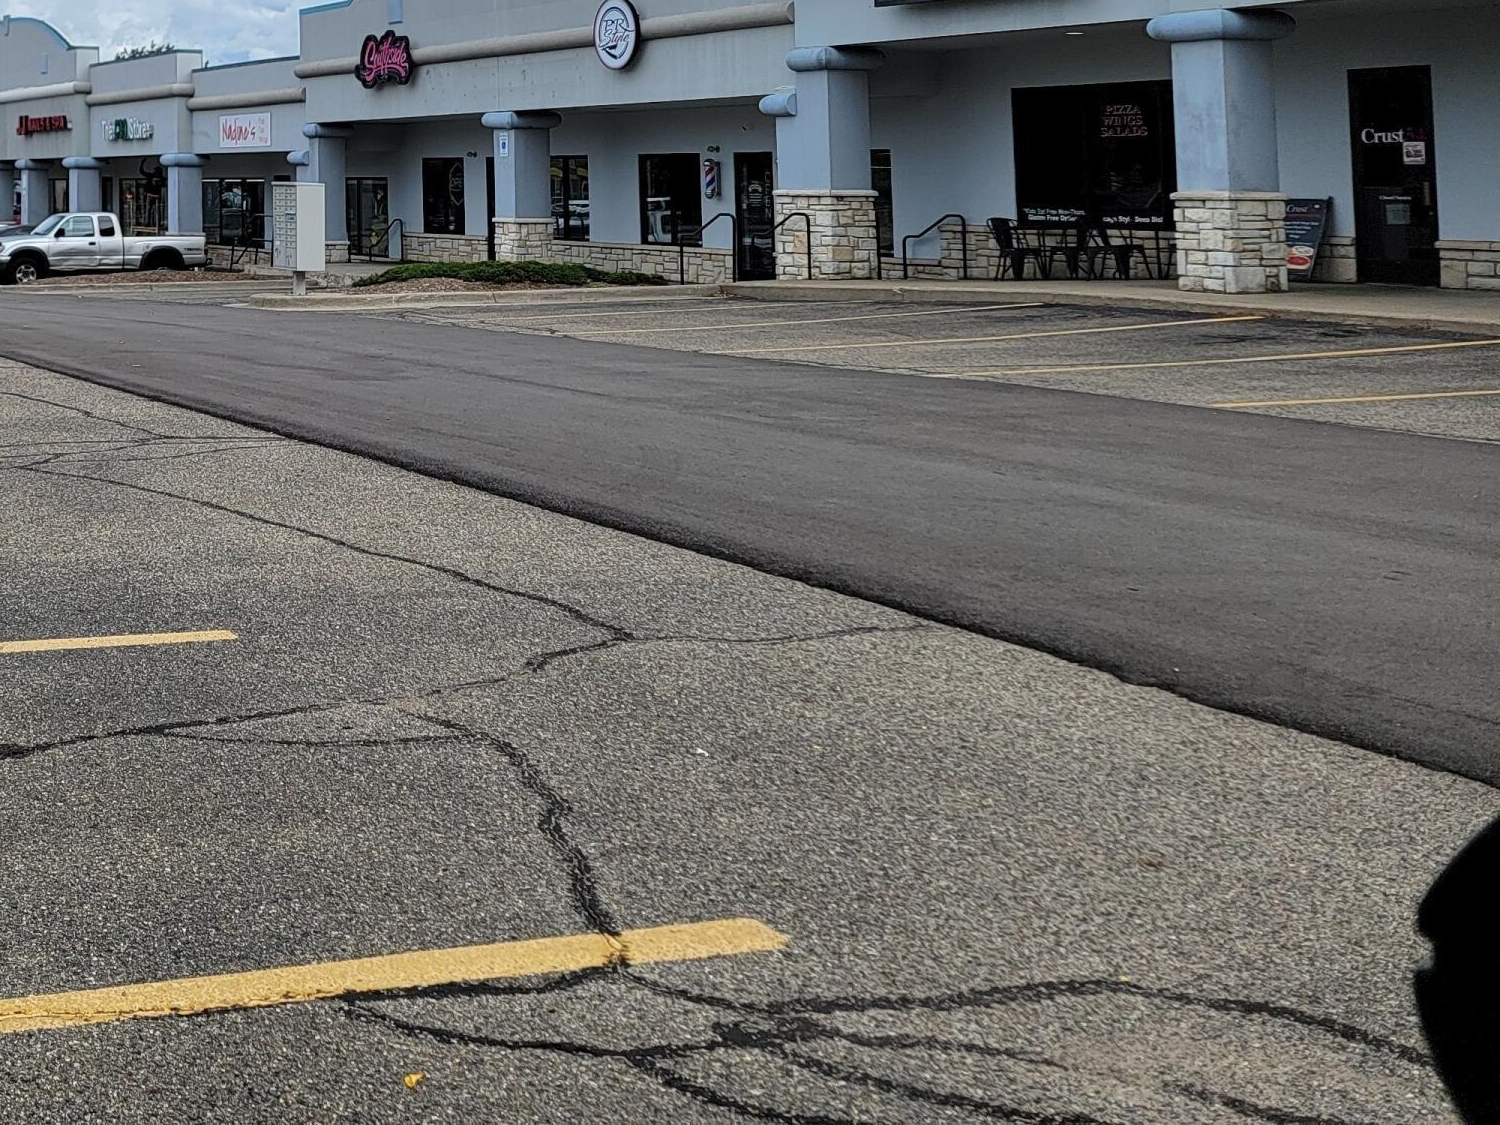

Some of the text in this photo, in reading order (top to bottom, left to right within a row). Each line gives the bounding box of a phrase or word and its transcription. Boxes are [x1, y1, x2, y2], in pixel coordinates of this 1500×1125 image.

[1104, 104, 1141, 115] PIZZA
[1103, 115, 1143, 126] WINGS
[1101, 126, 1148, 137] SALADS
